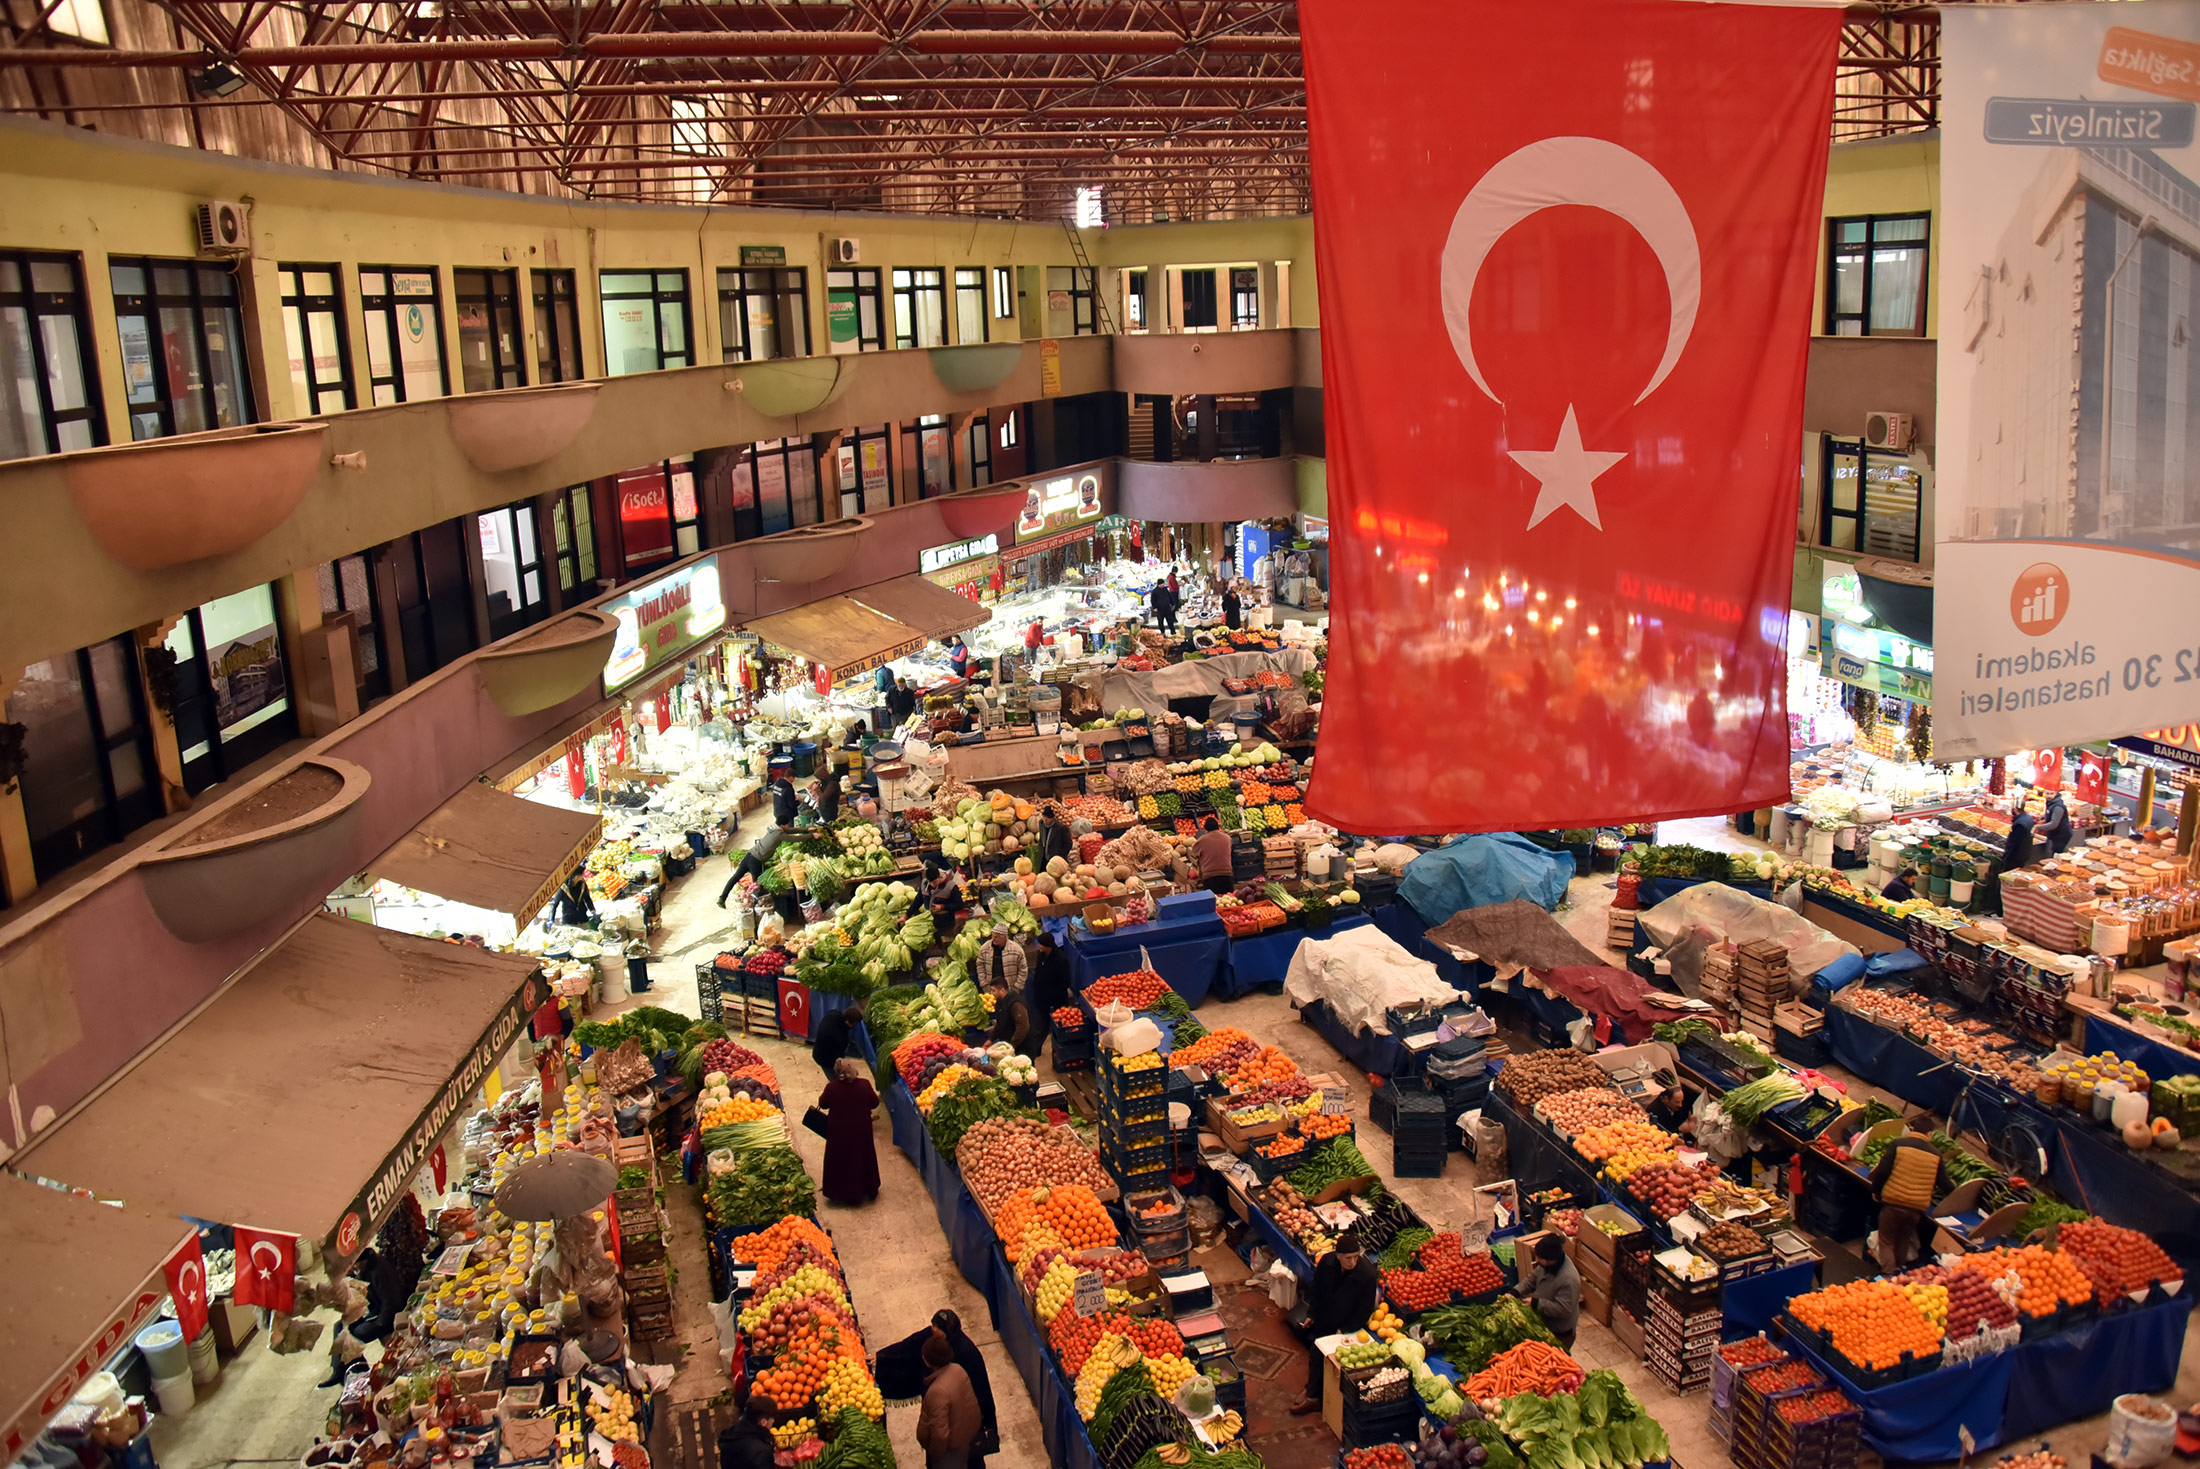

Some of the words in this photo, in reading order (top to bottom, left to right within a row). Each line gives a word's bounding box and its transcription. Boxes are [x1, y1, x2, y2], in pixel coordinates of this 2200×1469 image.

[392, 274, 411, 293] Sena
[657, 621, 678, 648] GIDA
[836, 661, 866, 681] KONYA
[871, 653, 887, 668] BAL
[892, 639, 924, 658] PAZARI
[562, 850, 579, 876] GIDA
[366, 1144, 415, 1222] ERMAN
[415, 1047, 483, 1159] ŞARKÜTERİ
[482, 1042, 493, 1065] &
[490, 1005, 520, 1053] GIDA
[40, 1290, 160, 1417] GIDA
